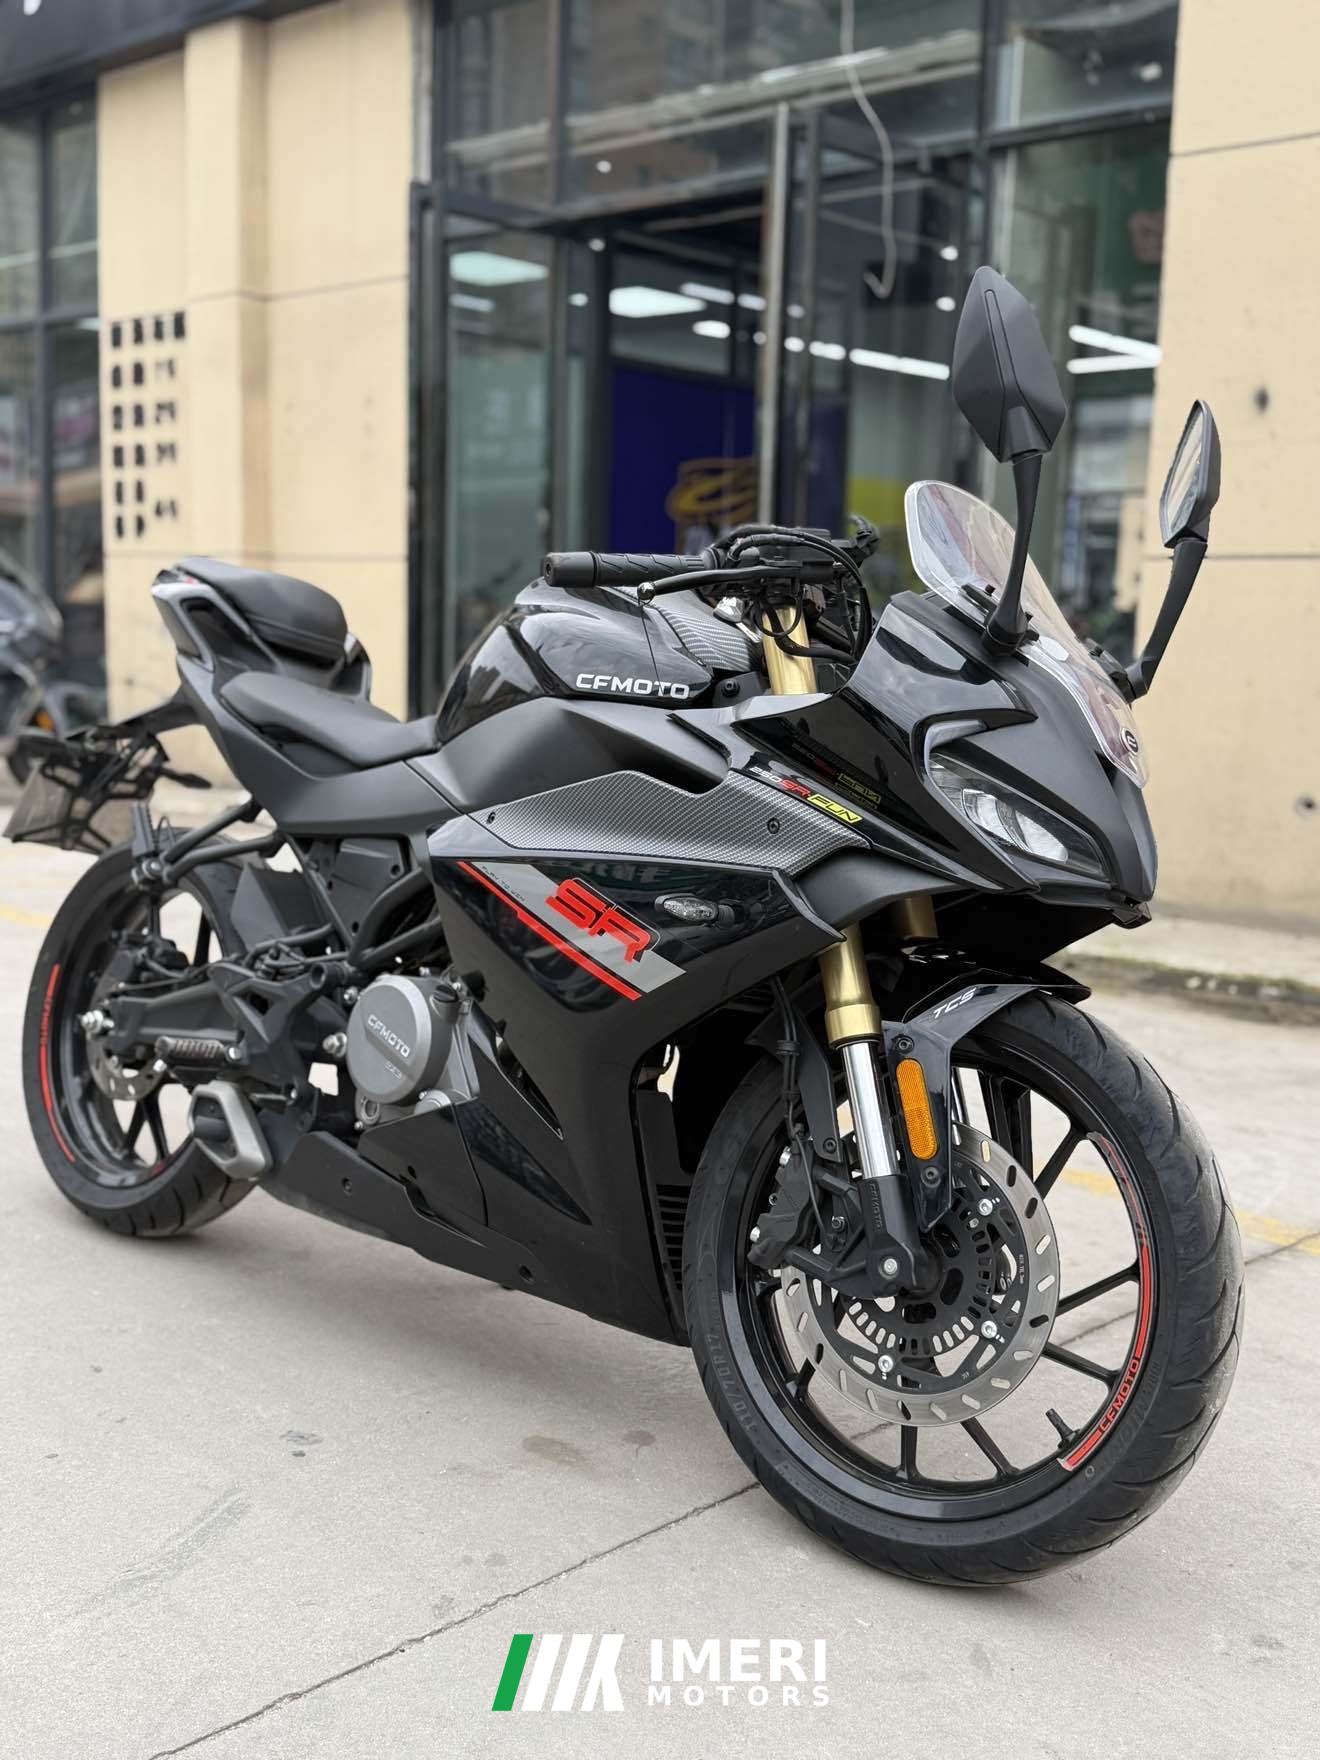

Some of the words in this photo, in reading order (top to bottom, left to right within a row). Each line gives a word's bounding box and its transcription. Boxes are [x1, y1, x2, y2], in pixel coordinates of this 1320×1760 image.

[576, 673, 690, 700] CFMOTO
[810, 795, 859, 822] FUN
[545, 877, 652, 964] SR
[933, 987, 977, 1019] TCS
[367, 1014, 411, 1058] CFMOTO
[1099, 1359, 1140, 1432] CFMOTO
